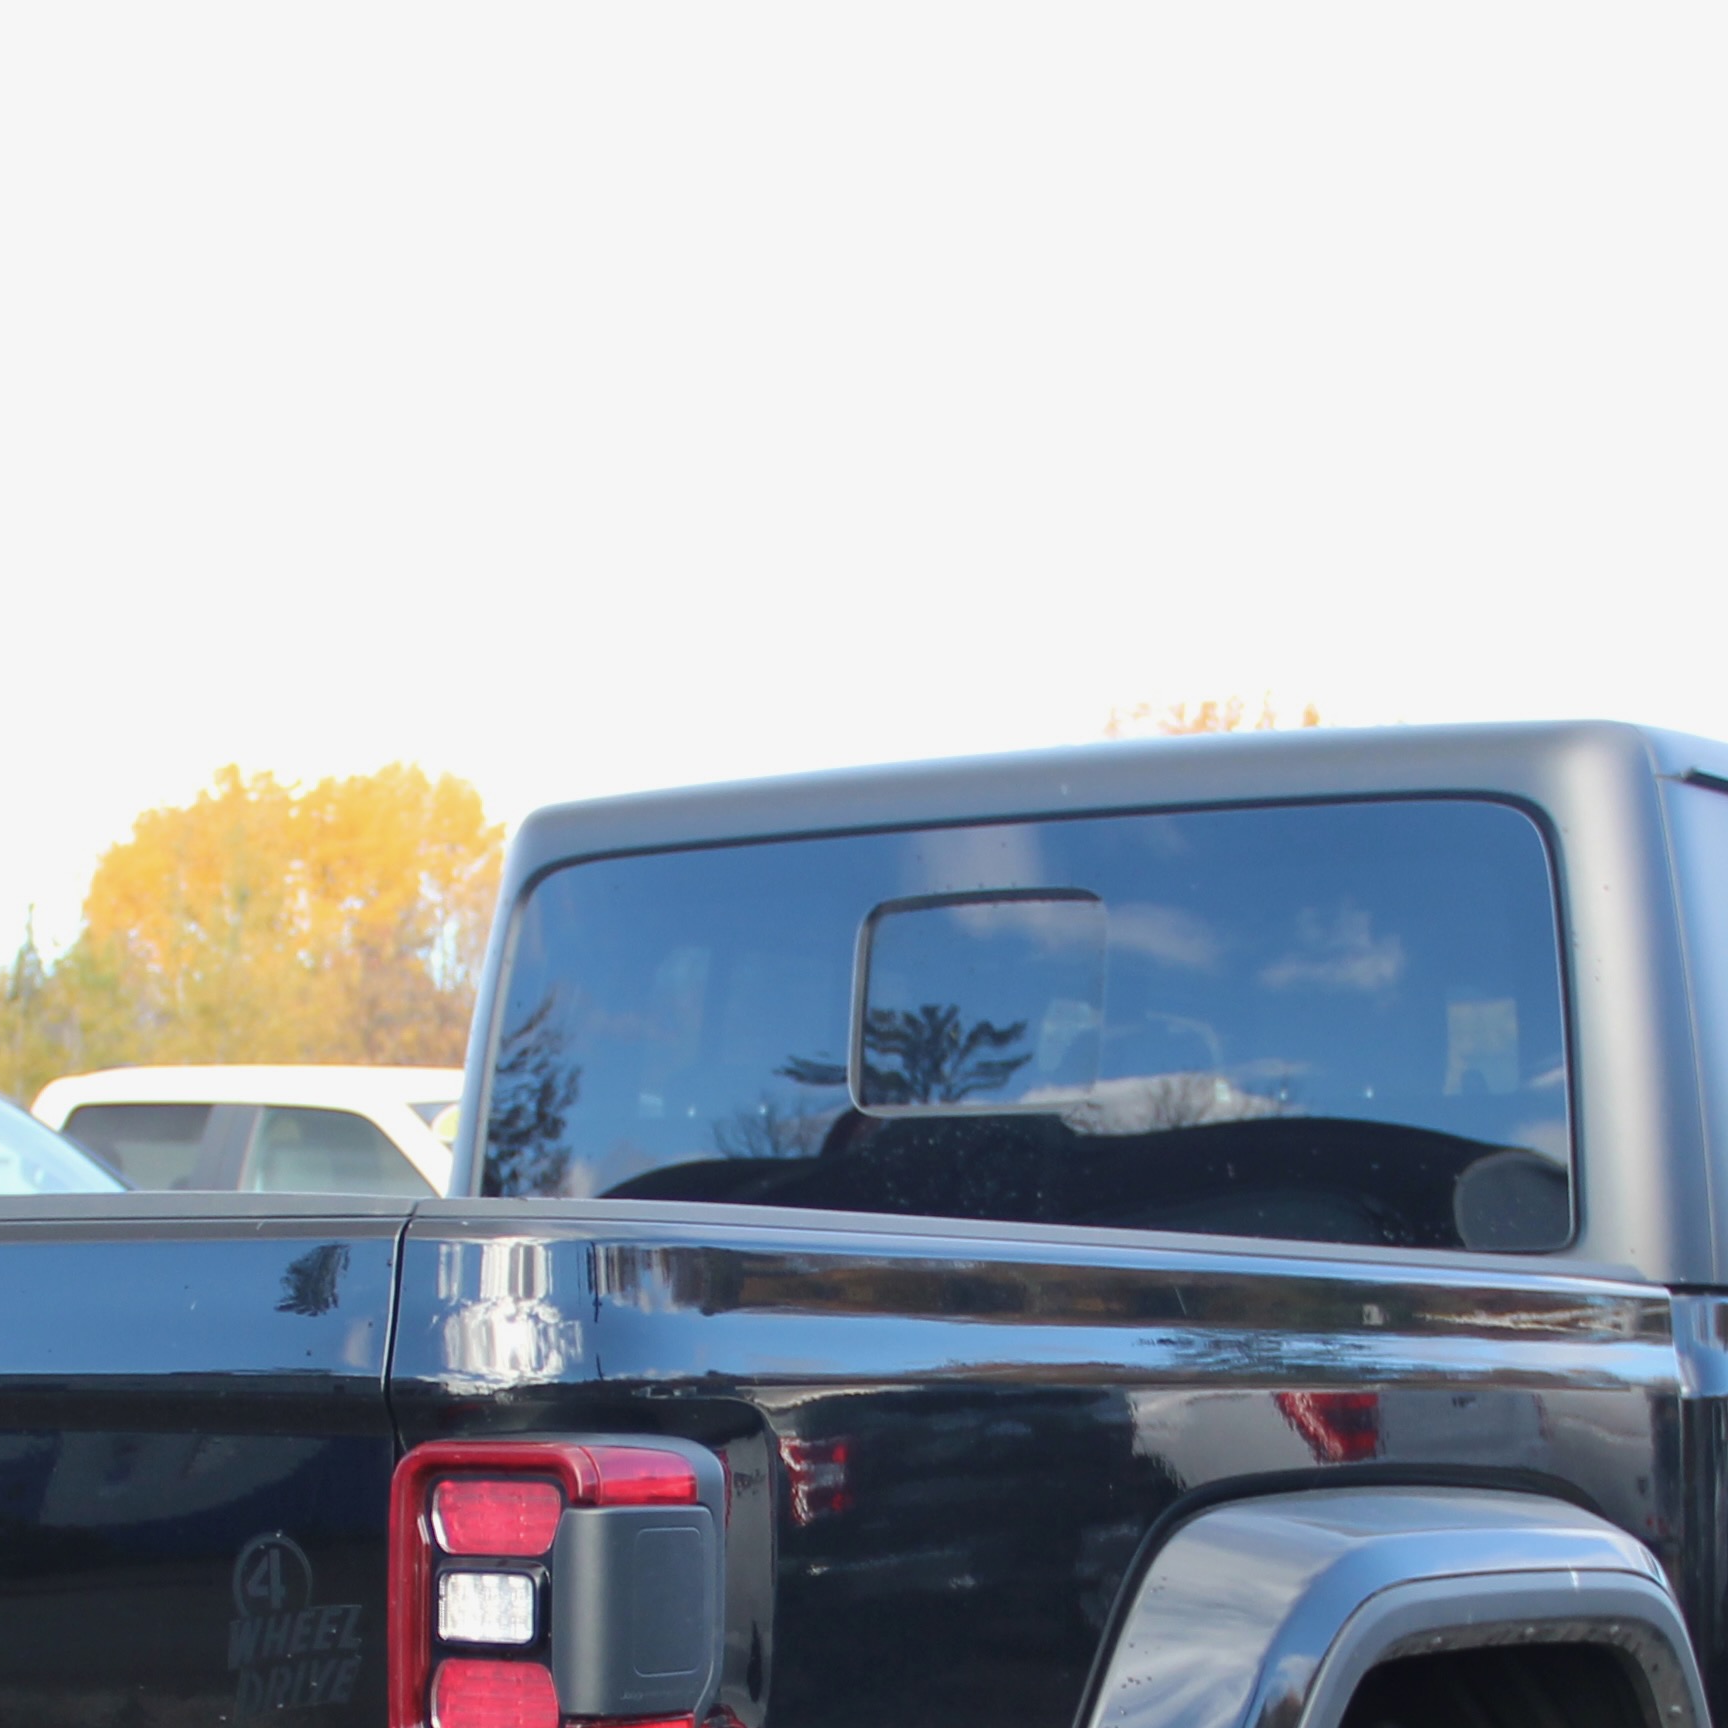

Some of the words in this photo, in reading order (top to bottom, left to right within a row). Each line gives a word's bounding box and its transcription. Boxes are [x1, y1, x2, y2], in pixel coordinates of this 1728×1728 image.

[246, 1548, 286, 1609] 4
[228, 1605, 362, 1670] WHEEL
[235, 1654, 362, 1722] DRIVE
